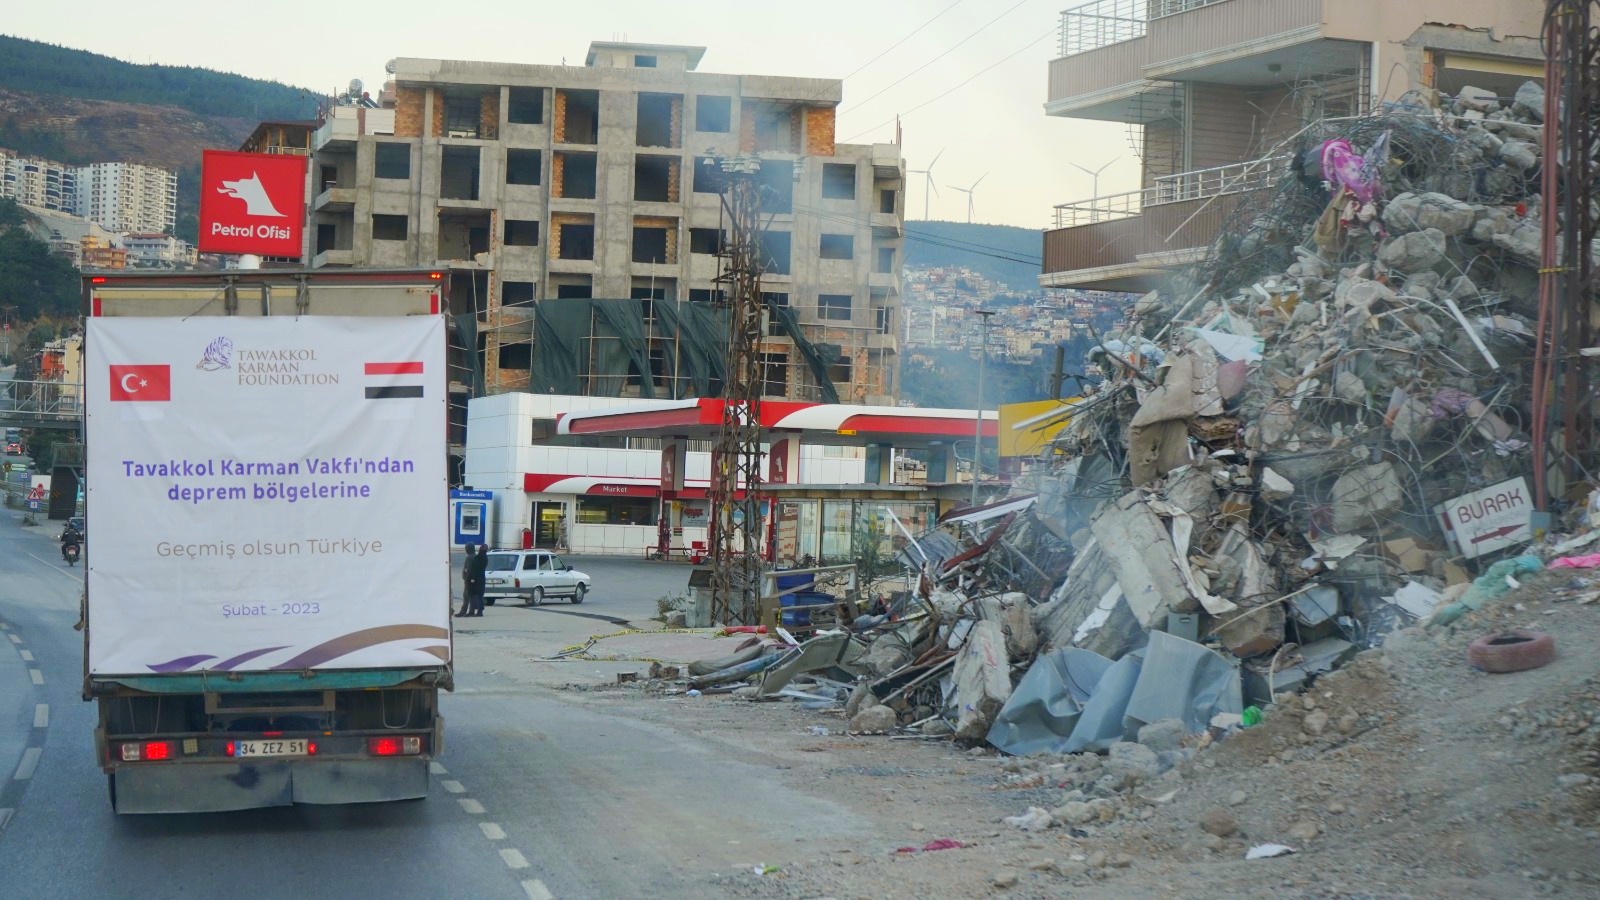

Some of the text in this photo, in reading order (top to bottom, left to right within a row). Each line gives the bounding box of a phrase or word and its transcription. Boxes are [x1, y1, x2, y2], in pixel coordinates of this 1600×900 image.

[211, 222, 290, 239] Petrol Ofisi
[237, 349, 318, 361] TAWAKKOL
[238, 361, 299, 373] KARMAN
[238, 373, 339, 385] FOUNDATION
[122, 456, 414, 477] Tavakkol Karman Vakfı'ndan
[168, 481, 370, 504] deprem bölgelerine
[602, 485, 628, 493] Market
[1457, 488, 1524, 524] BURAK
[156, 537, 383, 560] Geçmiş olsun Türkiye
[222, 603, 267, 619] Şubat
[282, 602, 320, 615] 2023
[241, 741, 303, 754] 34 ZEZ 51
